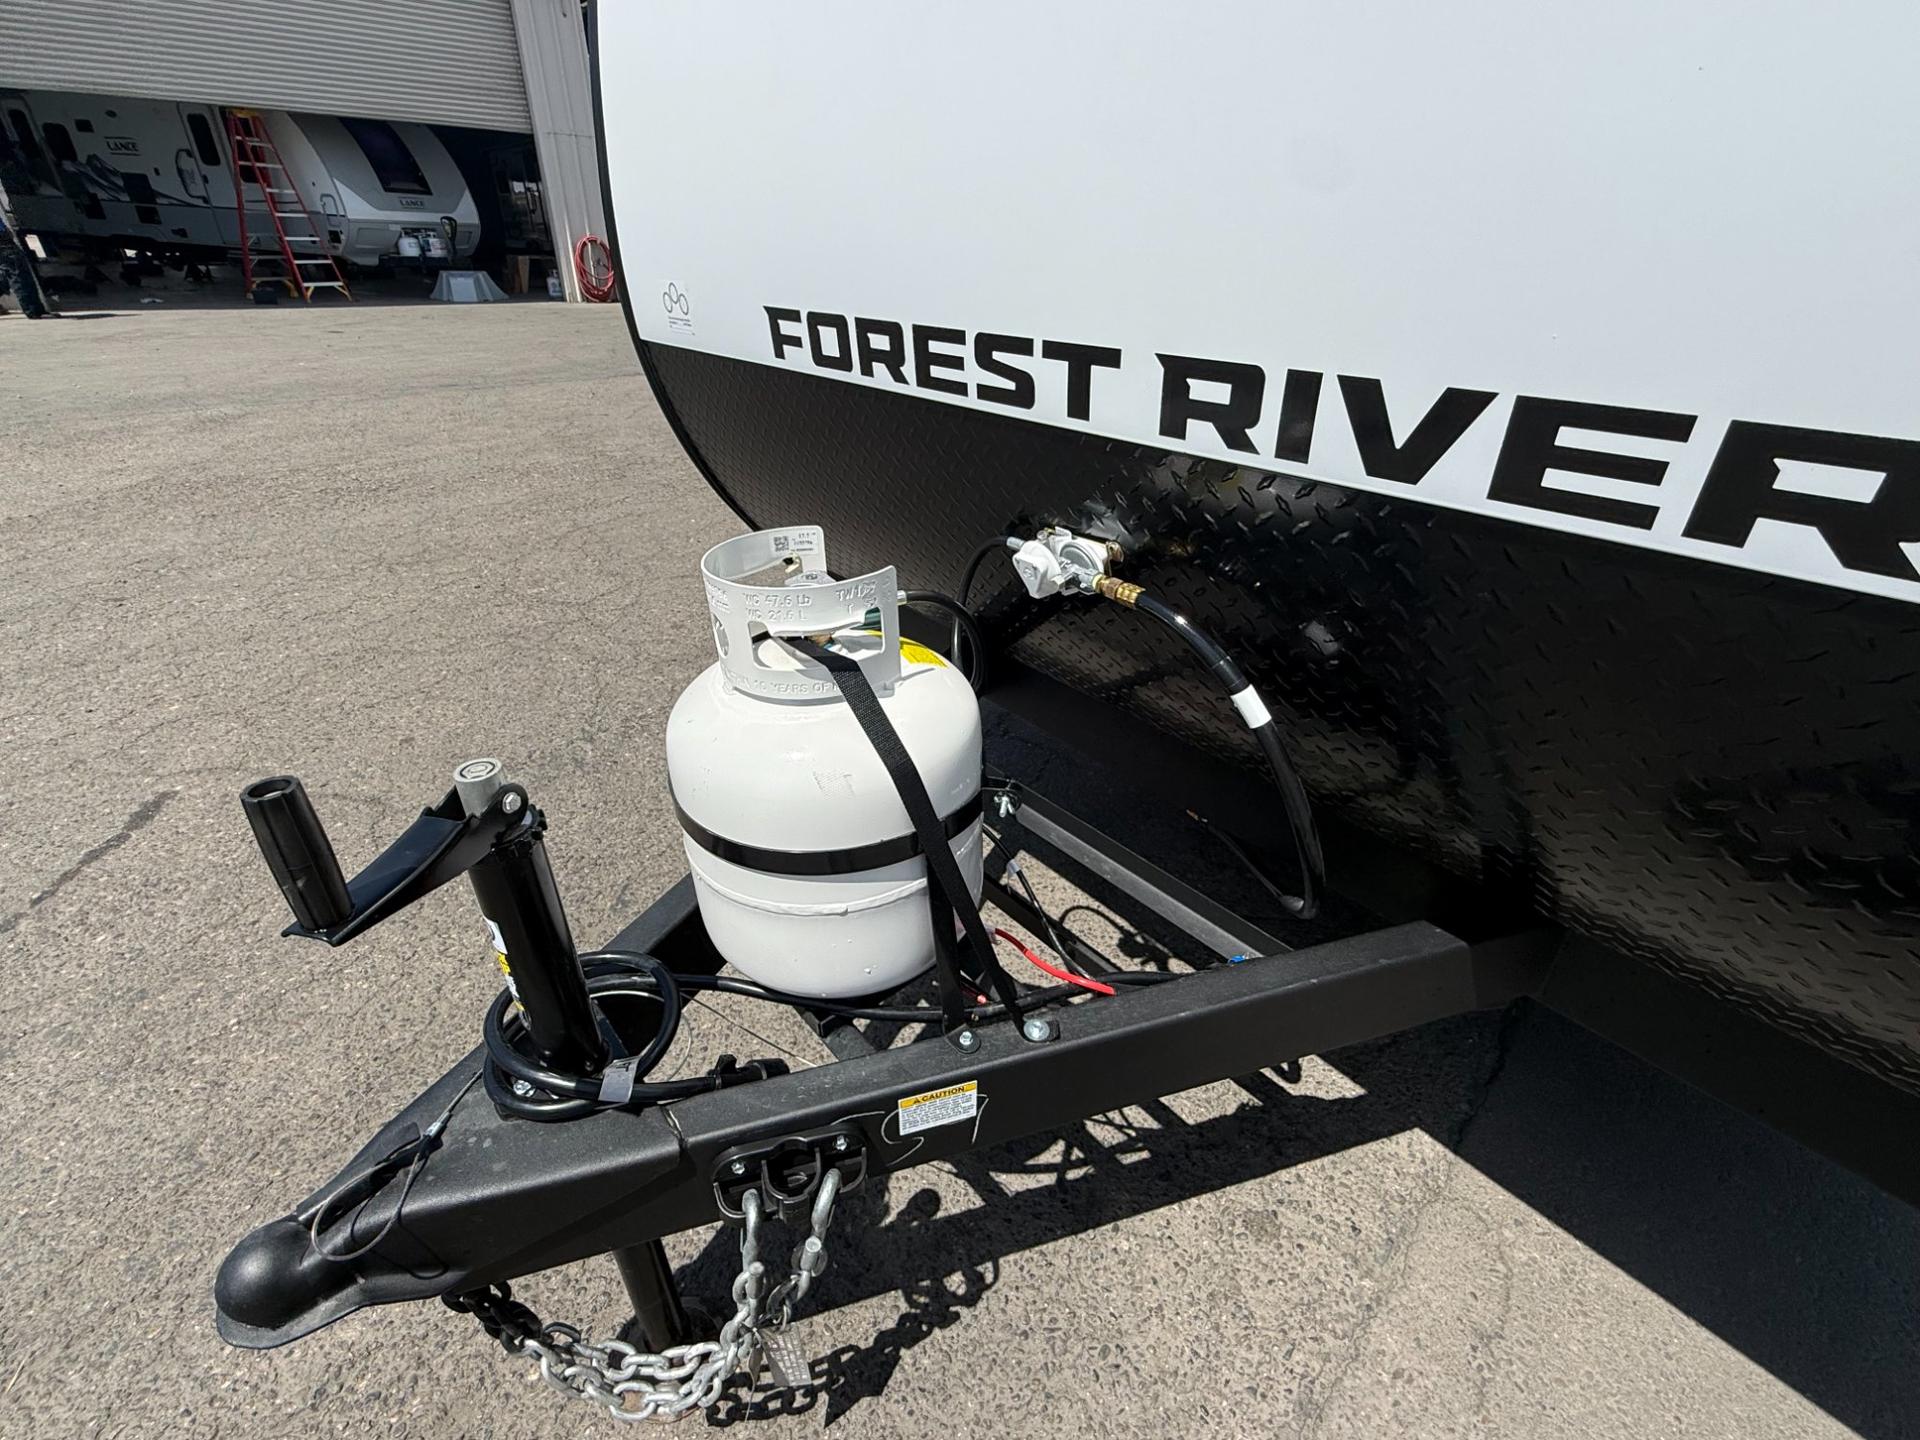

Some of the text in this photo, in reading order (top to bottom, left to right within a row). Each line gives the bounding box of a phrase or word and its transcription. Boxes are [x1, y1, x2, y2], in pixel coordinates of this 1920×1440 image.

[106, 141, 139, 152] LANCE
[763, 305, 1920, 583] FOREST RIVER
[770, 681, 808, 694] YEARS
[922, 1086, 965, 1102] CAUTION
